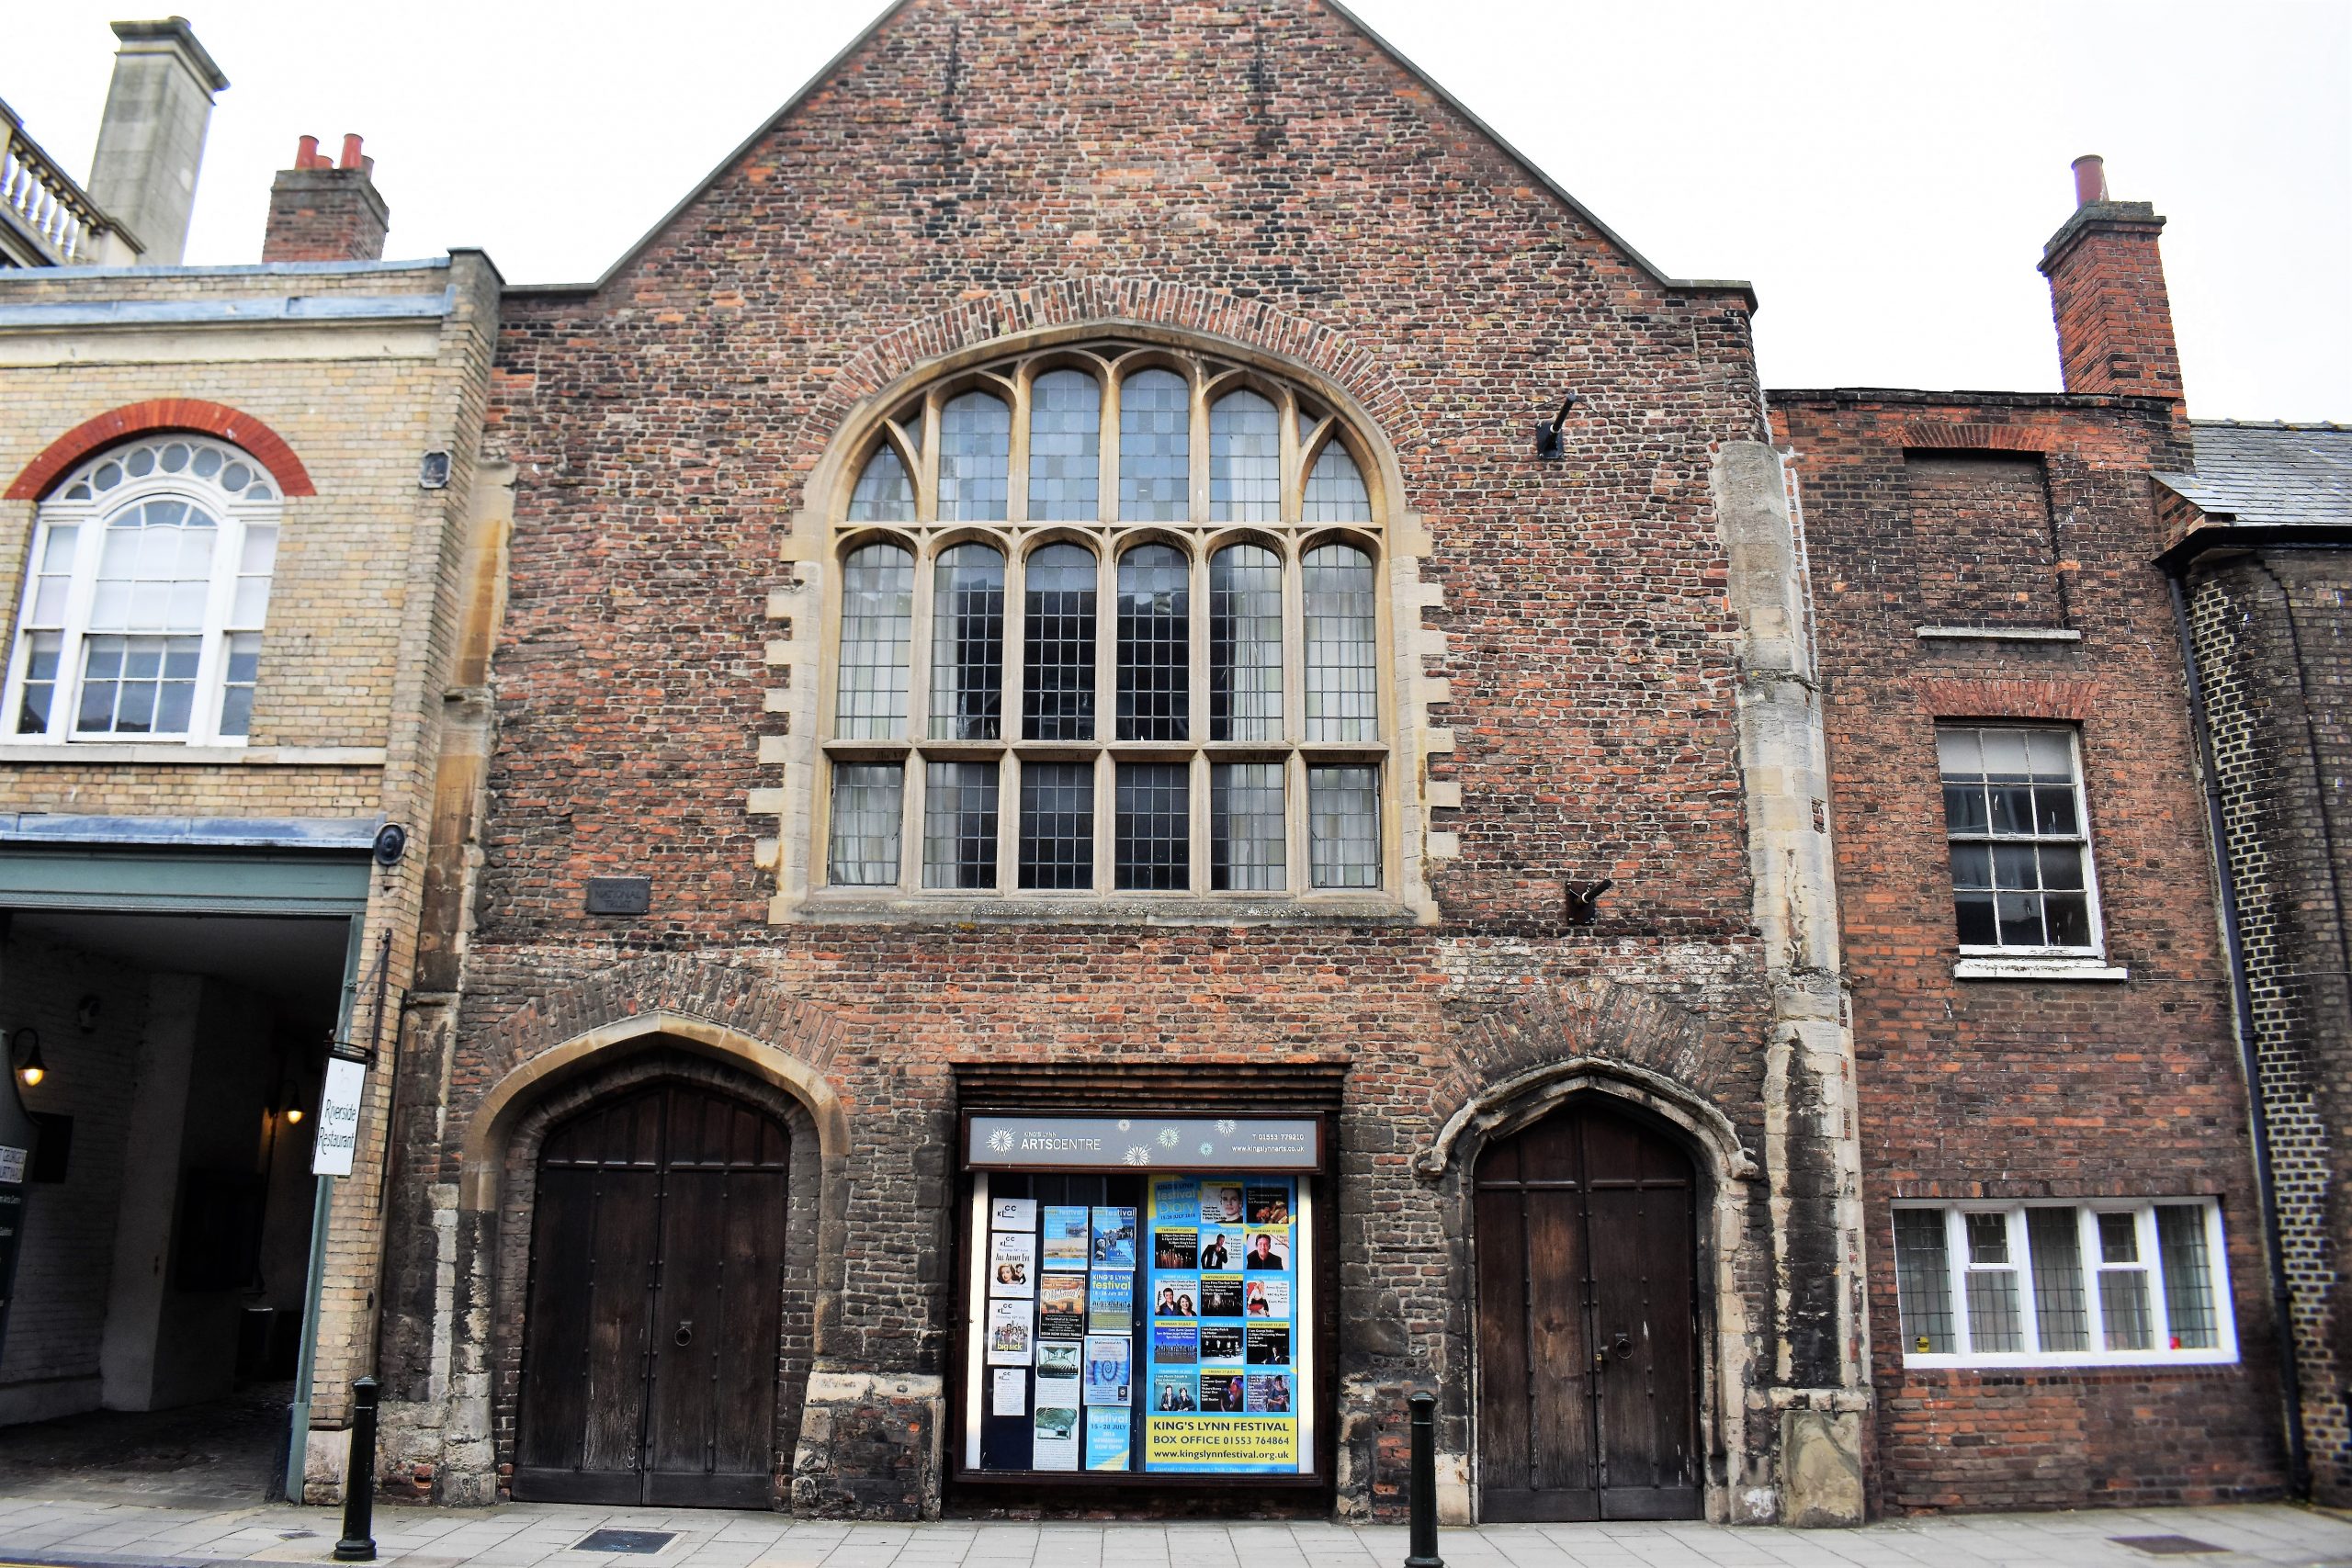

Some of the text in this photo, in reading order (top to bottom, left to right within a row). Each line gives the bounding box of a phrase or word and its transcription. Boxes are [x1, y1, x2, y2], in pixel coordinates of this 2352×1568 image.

[595, 890, 641, 899] NATIONAL
[325, 1099, 356, 1125] Riverside
[318, 1126, 355, 1155] Restaurant
[1021, 1138, 1102, 1150] ARTSCENTRE
[1232, 1145, 1305, 1153] www.kingslynnarts.co.uk
[1157, 1190, 1195, 1201] festival
[1159, 1201, 1195, 1215] Diary
[1092, 1280, 1131, 1290] festival
[1091, 1415, 1128, 1424] festival
[1153, 1421, 1289, 1431] KING'S LYNN FESTIVAL
[1153, 1436, 1289, 1445] BOX OFFICE 01553 764864
[1154, 1450, 1289, 1461] www.kingslynnfestival.org.uk
